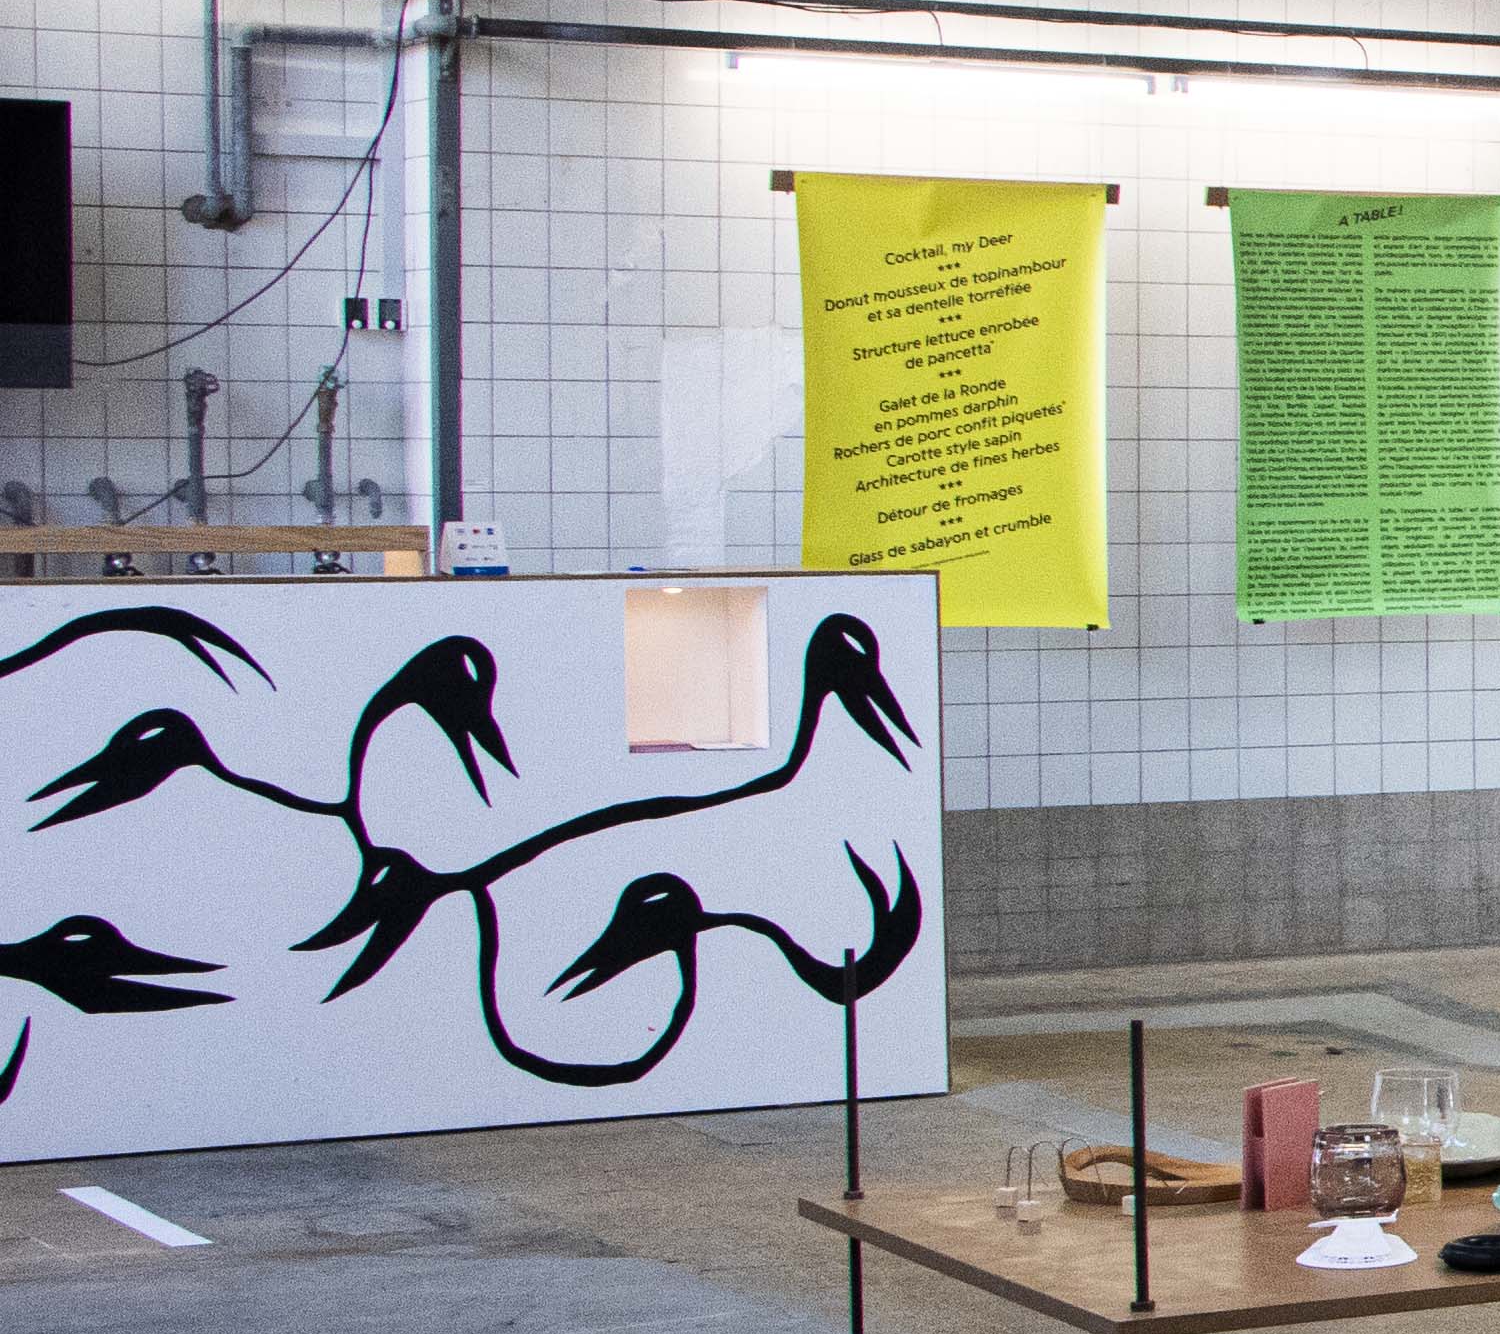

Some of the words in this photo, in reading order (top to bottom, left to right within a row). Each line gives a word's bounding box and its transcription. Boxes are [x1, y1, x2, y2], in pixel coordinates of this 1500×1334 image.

[952, 241, 974, 253] my
[978, 234, 1014, 249] Deer
[824, 293, 870, 312] Donut
[873, 281, 946, 302] mousseux
[949, 276, 968, 288] de
[972, 258, 1067, 284] topinambour
[867, 309, 882, 323] et
[886, 308, 902, 319] sa
[905, 294, 964, 315] dentelle
[852, 339, 922, 361] Structure
[925, 328, 976, 347] lettuce
[904, 356, 924, 370] de
[873, 421, 893, 433] en
[896, 407, 959, 430] pommes
[963, 395, 1018, 415] darphin
[879, 395, 917, 413] Galet
[920, 392, 940, 405] de
[943, 388, 956, 400] la
[959, 379, 1007, 397] Ronde
[833, 440, 891, 460] Rochers
[894, 435, 914, 447] de
[917, 427, 951, 445] porc
[955, 416, 997, 435] confit
[886, 448, 943, 468] Carotte
[946, 439, 981, 456] style
[984, 430, 1022, 448] sapin
[855, 465, 946, 493] Architecture
[950, 461, 969, 473] de
[972, 452, 1008, 468] fines
[1011, 441, 1061, 460] herbes
[931, 500, 951, 513] de
[954, 484, 1023, 507] fromages
[848, 550, 884, 567] Glass
[887, 545, 907, 558] de
[910, 531, 971, 553] sabayon
[974, 526, 990, 539] et
[993, 513, 1052, 535] crumble
